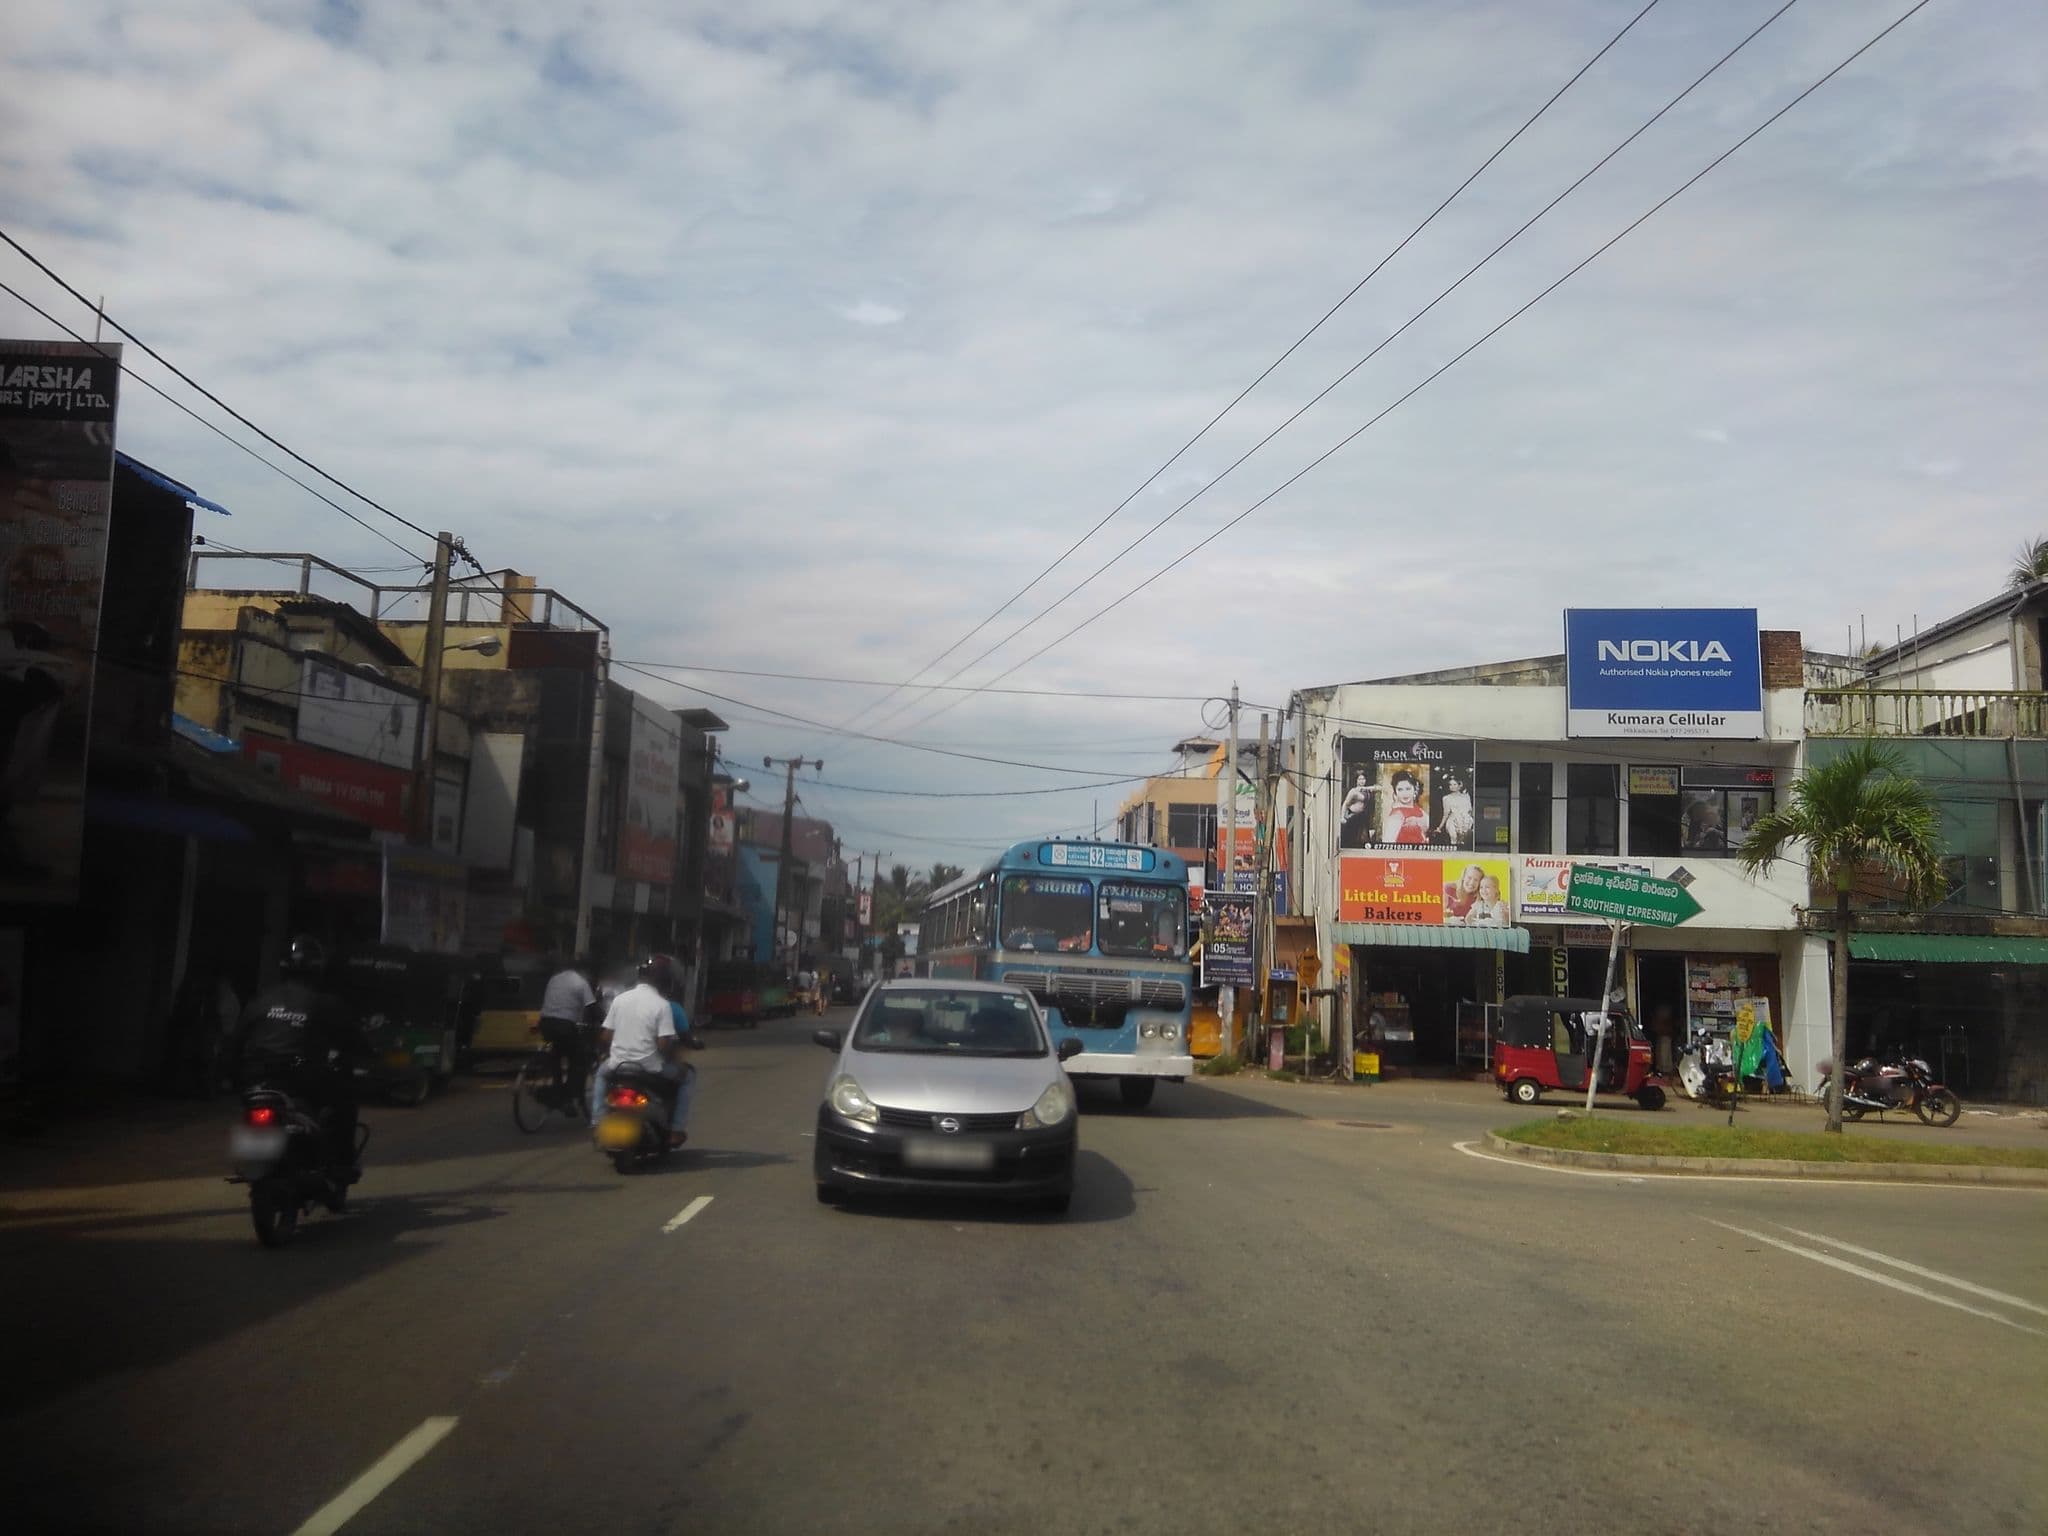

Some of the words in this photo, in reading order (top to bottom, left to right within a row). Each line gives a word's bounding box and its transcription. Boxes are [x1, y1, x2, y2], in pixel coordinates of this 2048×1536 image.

[0, 365, 92, 390] ARSHA
[1598, 640, 1732, 662] NOKIA
[1599, 668, 1645, 677] Authorised
[1645, 668, 1669, 677] Nokia
[1670, 669, 1701, 678] phones
[1702, 669, 1733, 677] reseller
[1608, 713, 1664, 726] Kumara
[1669, 713, 1726, 726] Cellular
[1373, 750, 1407, 760] SALON
[1091, 848, 1104, 865] 32
[1100, 884, 1167, 900] EXPRESS
[1343, 889, 1389, 903] Little
[1392, 890, 1441, 904] Lanka
[1364, 907, 1423, 921] Bakers
[1570, 895, 1582, 907] TO
[1582, 897, 1625, 915] SOUTHERN
[1627, 905, 1679, 924] EXPRESSWAY
